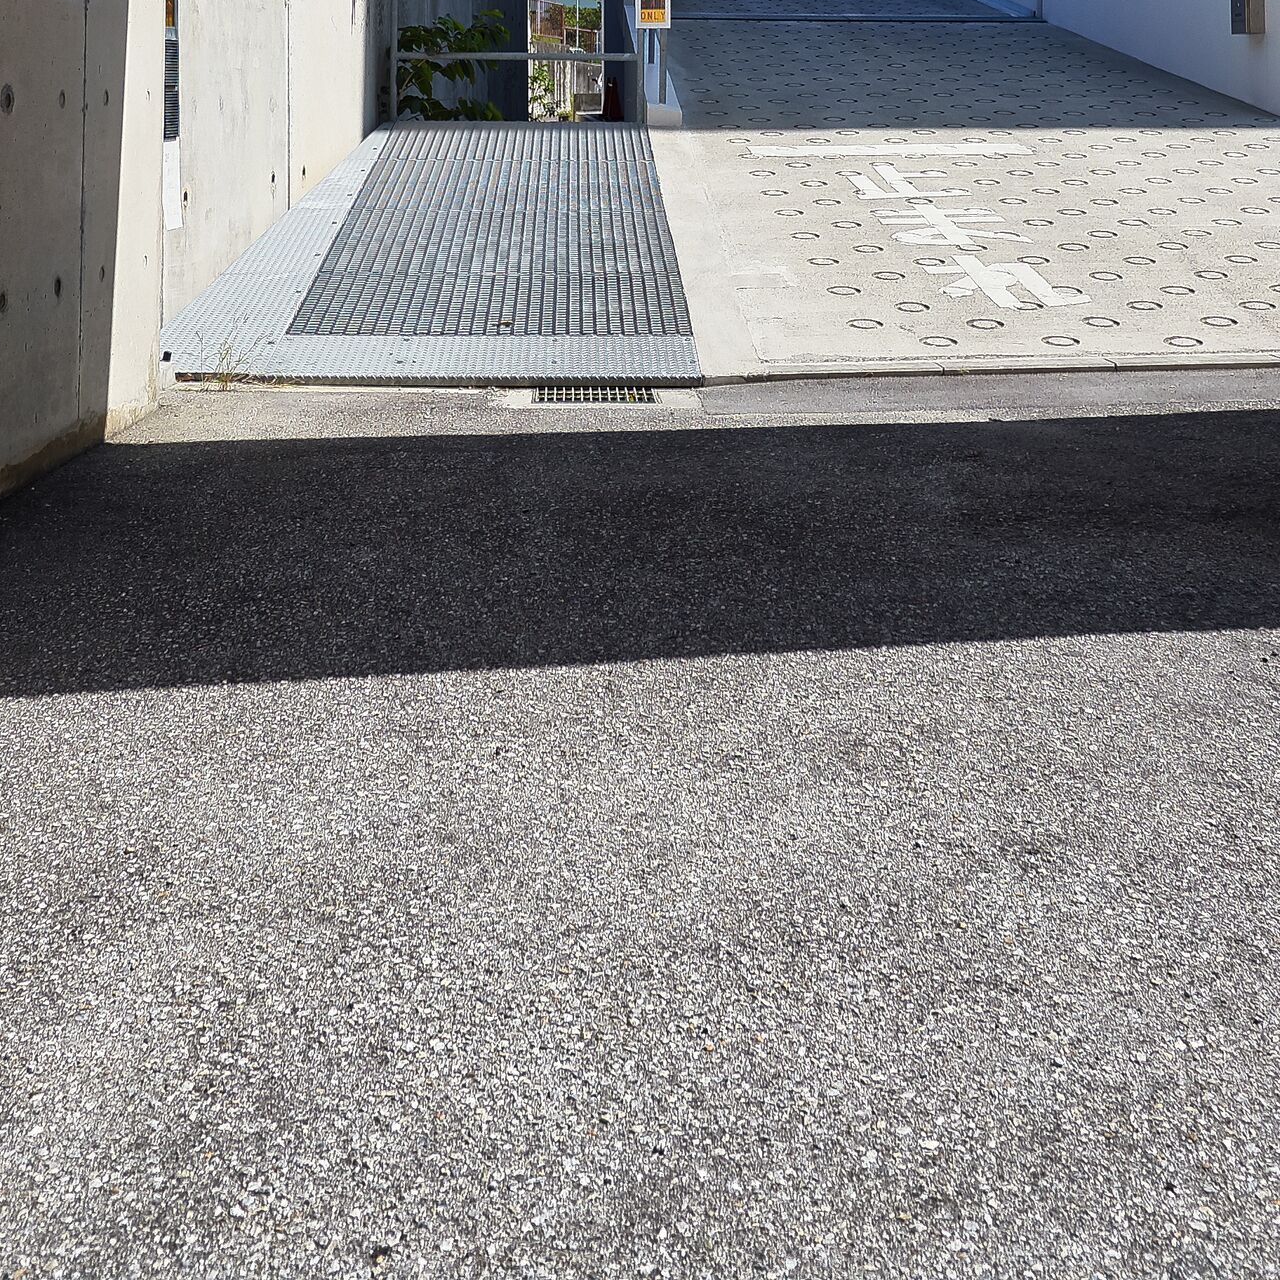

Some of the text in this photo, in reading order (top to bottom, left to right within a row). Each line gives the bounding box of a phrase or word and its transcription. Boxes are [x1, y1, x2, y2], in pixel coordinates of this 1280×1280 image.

[641, 12, 665, 20] ONLY
[846, 163, 1092, 310] 止まれ
